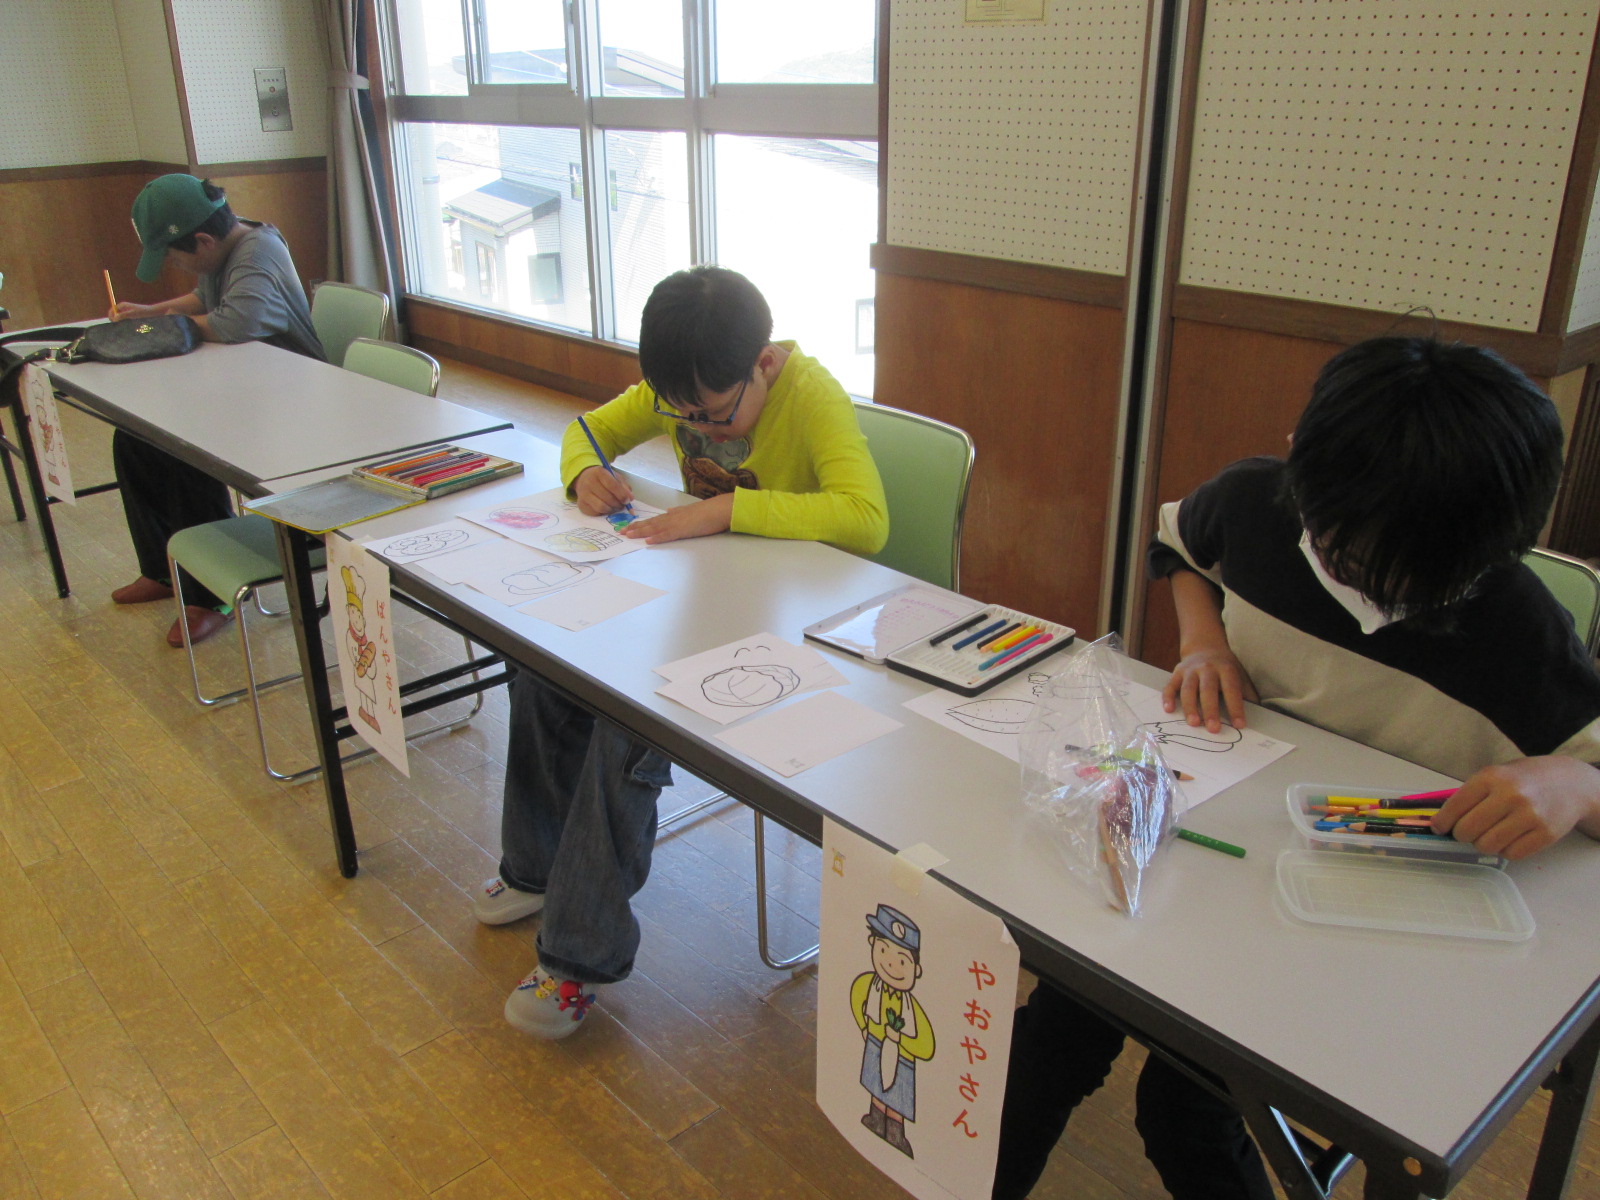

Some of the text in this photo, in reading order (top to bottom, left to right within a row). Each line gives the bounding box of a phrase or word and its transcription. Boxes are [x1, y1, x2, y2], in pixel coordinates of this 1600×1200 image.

[952, 960, 996, 1139] やおやさん
